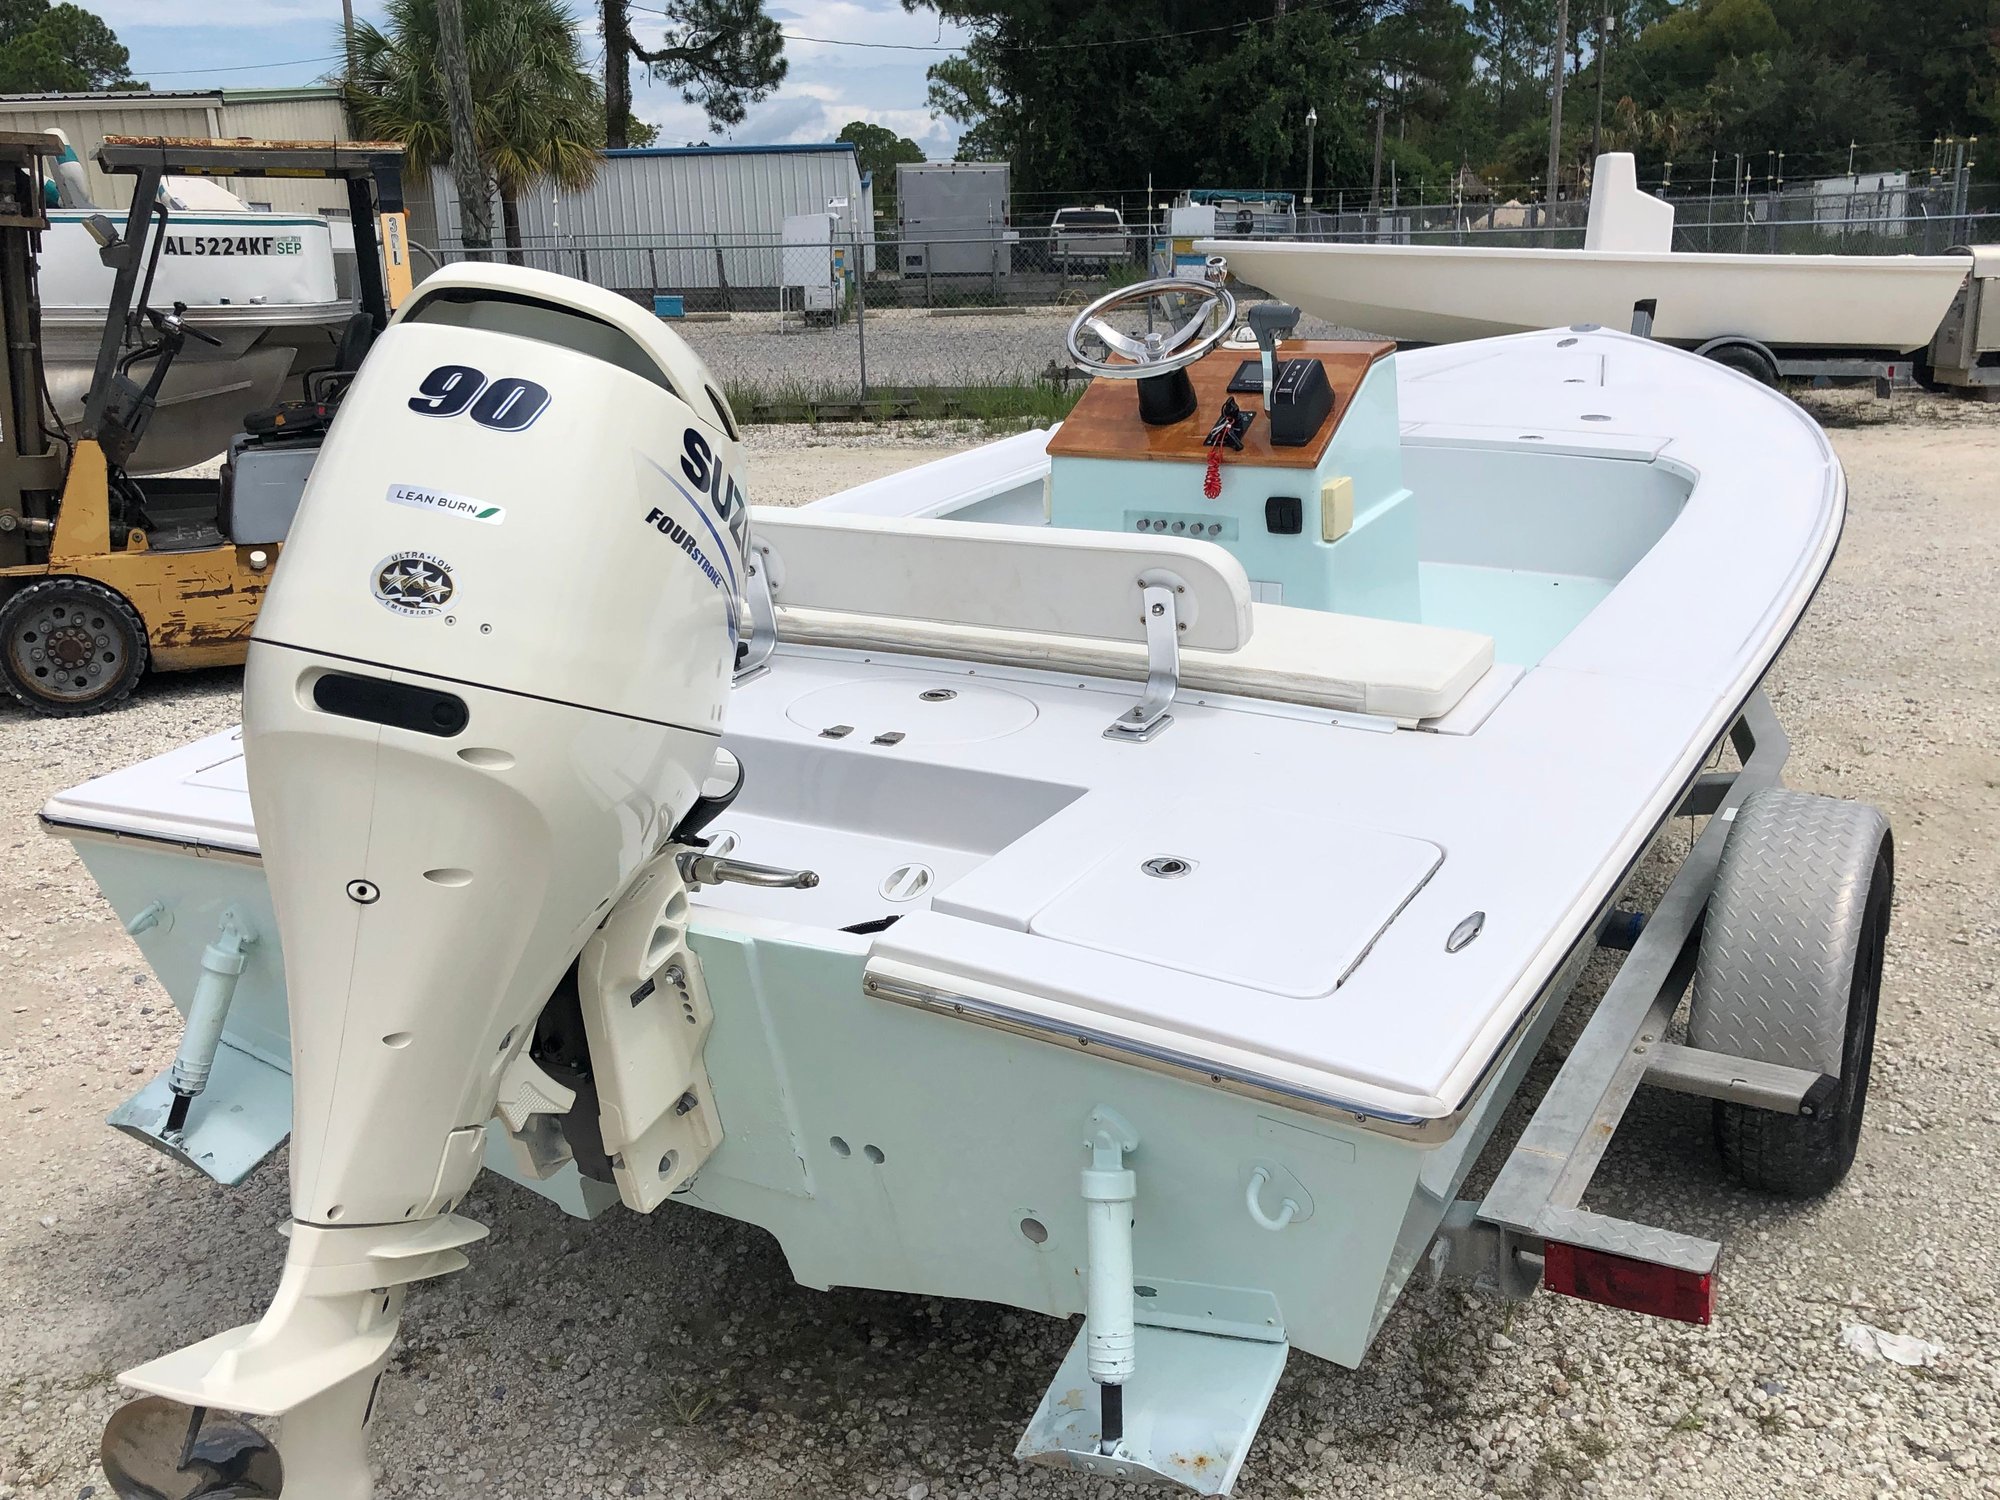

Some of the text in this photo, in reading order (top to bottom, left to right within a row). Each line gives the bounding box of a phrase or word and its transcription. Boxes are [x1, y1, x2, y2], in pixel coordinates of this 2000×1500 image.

[275, 242, 302, 255] SEP
[407, 364, 553, 433] 90
[396, 489, 478, 514] LEAN BURN
[385, 600, 434, 615] EMISSION
